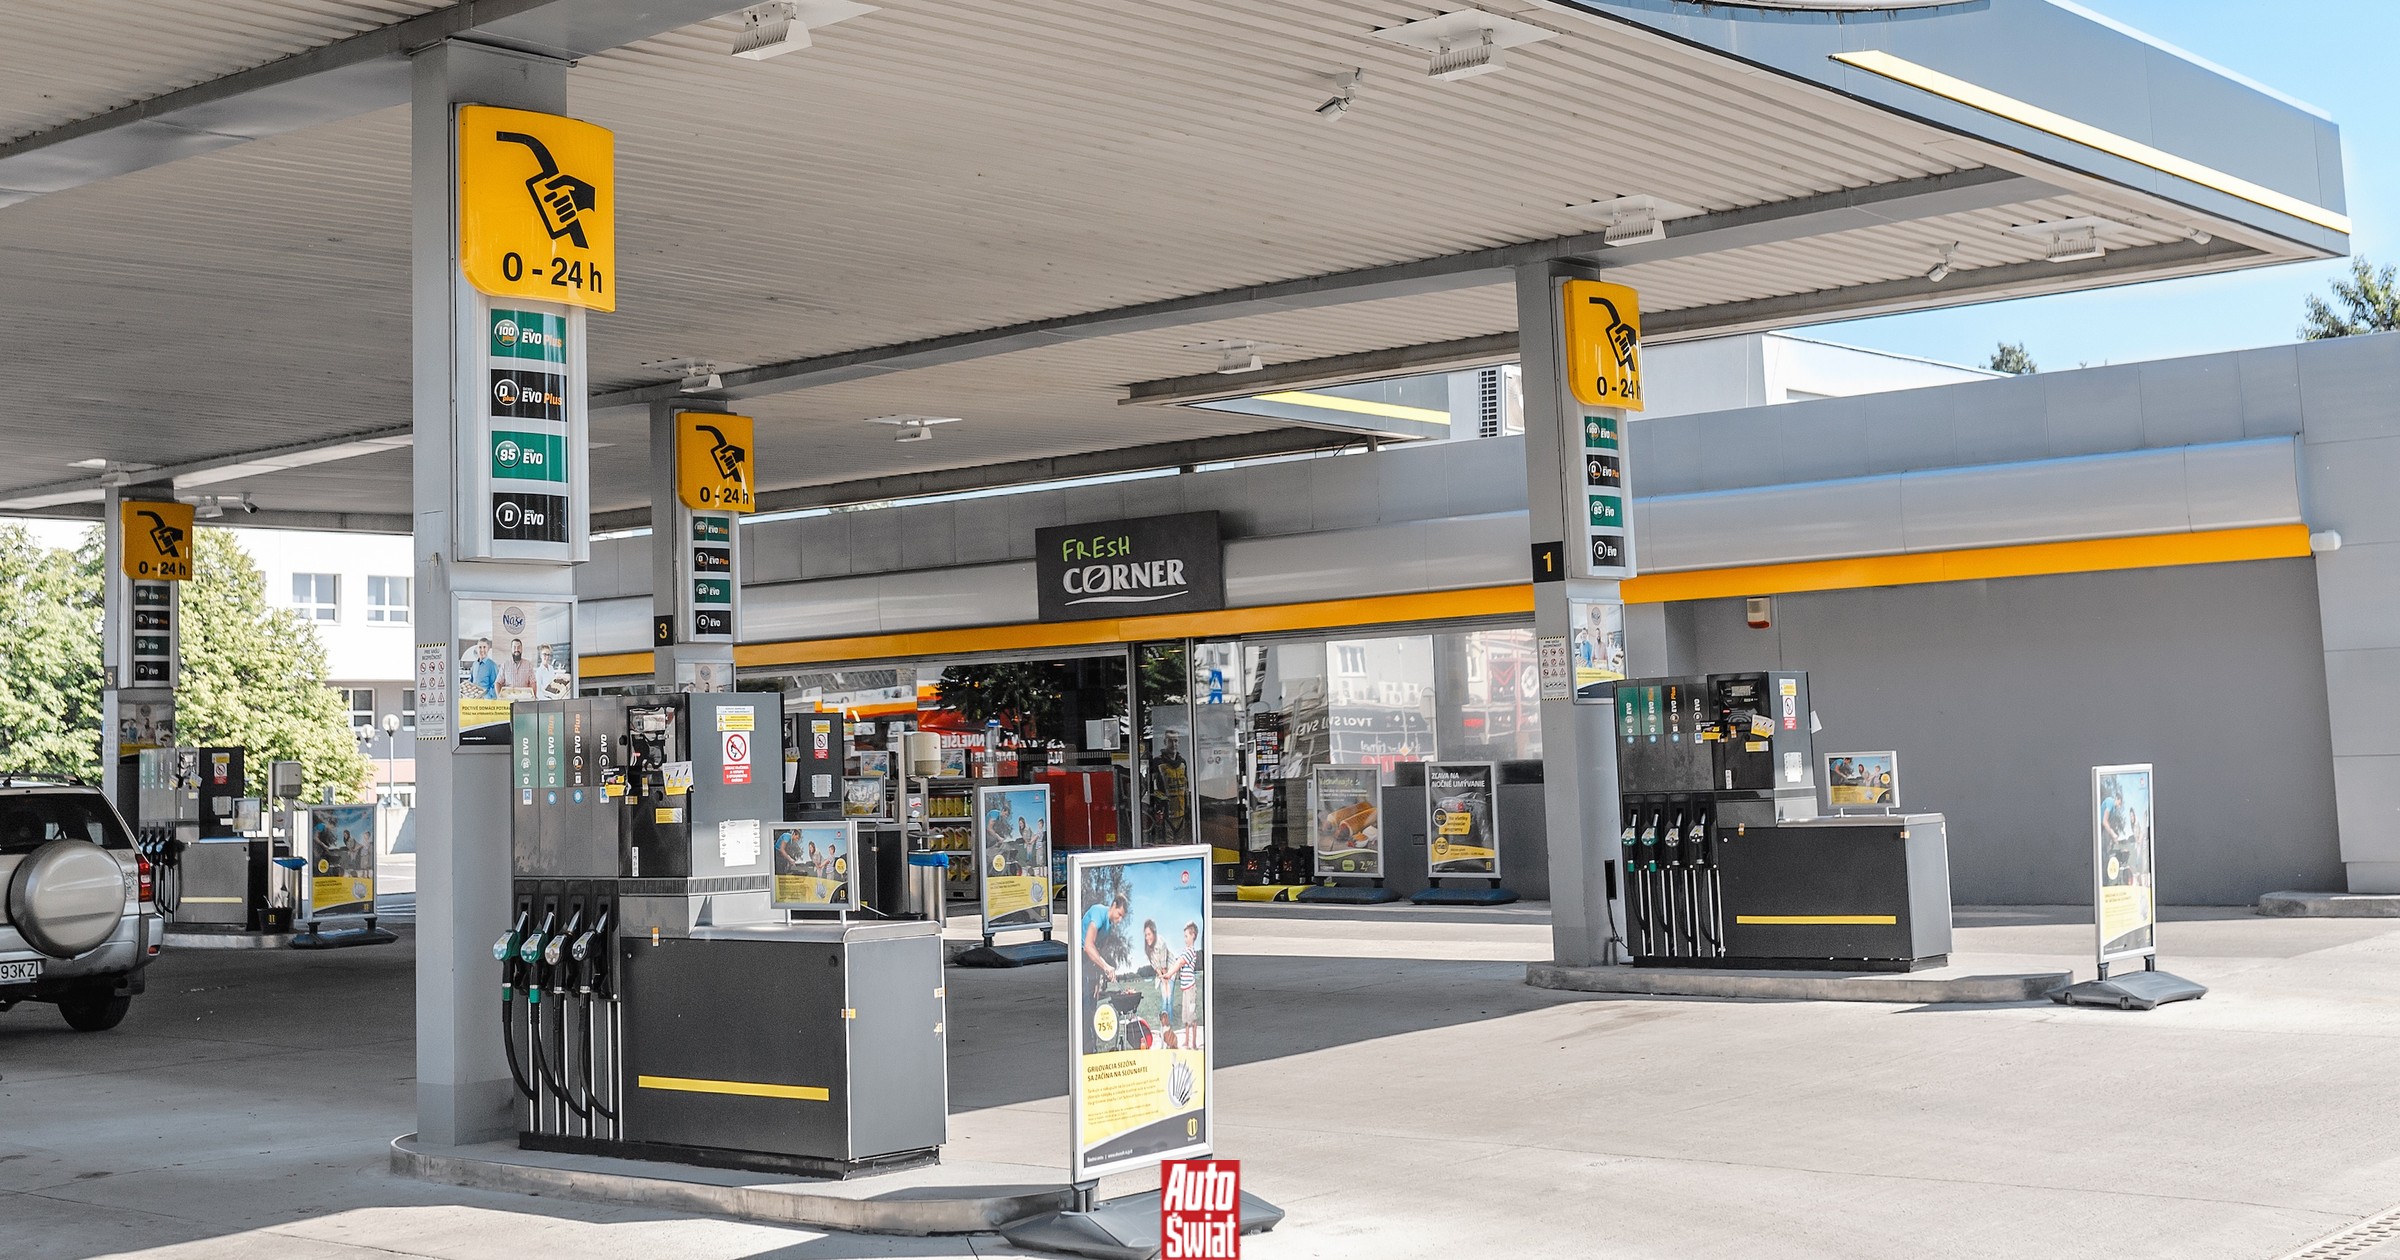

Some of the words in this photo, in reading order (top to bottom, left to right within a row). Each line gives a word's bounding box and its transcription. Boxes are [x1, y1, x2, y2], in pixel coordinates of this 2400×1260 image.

[503, 252, 523, 282] 0
[551, 257, 583, 289] 24
[589, 261, 602, 294] h
[499, 326, 515, 336] 100
[522, 332, 542, 345] EVO
[543, 334, 563, 348] Plus
[499, 385, 508, 397] D
[522, 391, 542, 403] EVO
[543, 392, 563, 406] Plus
[1596, 376, 1608, 396] 0
[1620, 378, 1635, 399] 24
[1600, 430, 1610, 439] EVO
[500, 449, 516, 461] 95
[523, 452, 543, 465] EVO
[1602, 468, 1612, 477] EVO
[700, 487, 710, 502] 0
[723, 488, 739, 503] 24
[742, 489, 749, 504] h
[504, 509, 514, 522] D
[523, 513, 544, 526] EVO
[1593, 506, 1602, 515] 95
[1605, 508, 1615, 517] EVO
[1062, 535, 1131, 562] FRESH
[1598, 546, 1603, 555] D
[1607, 548, 1617, 557] EVO
[138, 561, 148, 574] 0
[160, 561, 176, 575] 24
[179, 562, 186, 576] h
[1543, 551, 1552, 572] 1
[1062, 559, 1187, 594] CORNER
[709, 588, 720, 596] EVO
[659, 623, 667, 639] 3
[710, 619, 721, 627] EVO
[107, 672, 113, 686] 5
[1431, 772, 1449, 780] ZĽAVA
[1431, 779, 1452, 788] NOČNÉ
[1452, 779, 1485, 788] UMÝVANIE
[0, 963, 35, 979] 93KZ
[1095, 1071, 1114, 1081] ZAČÍNA
